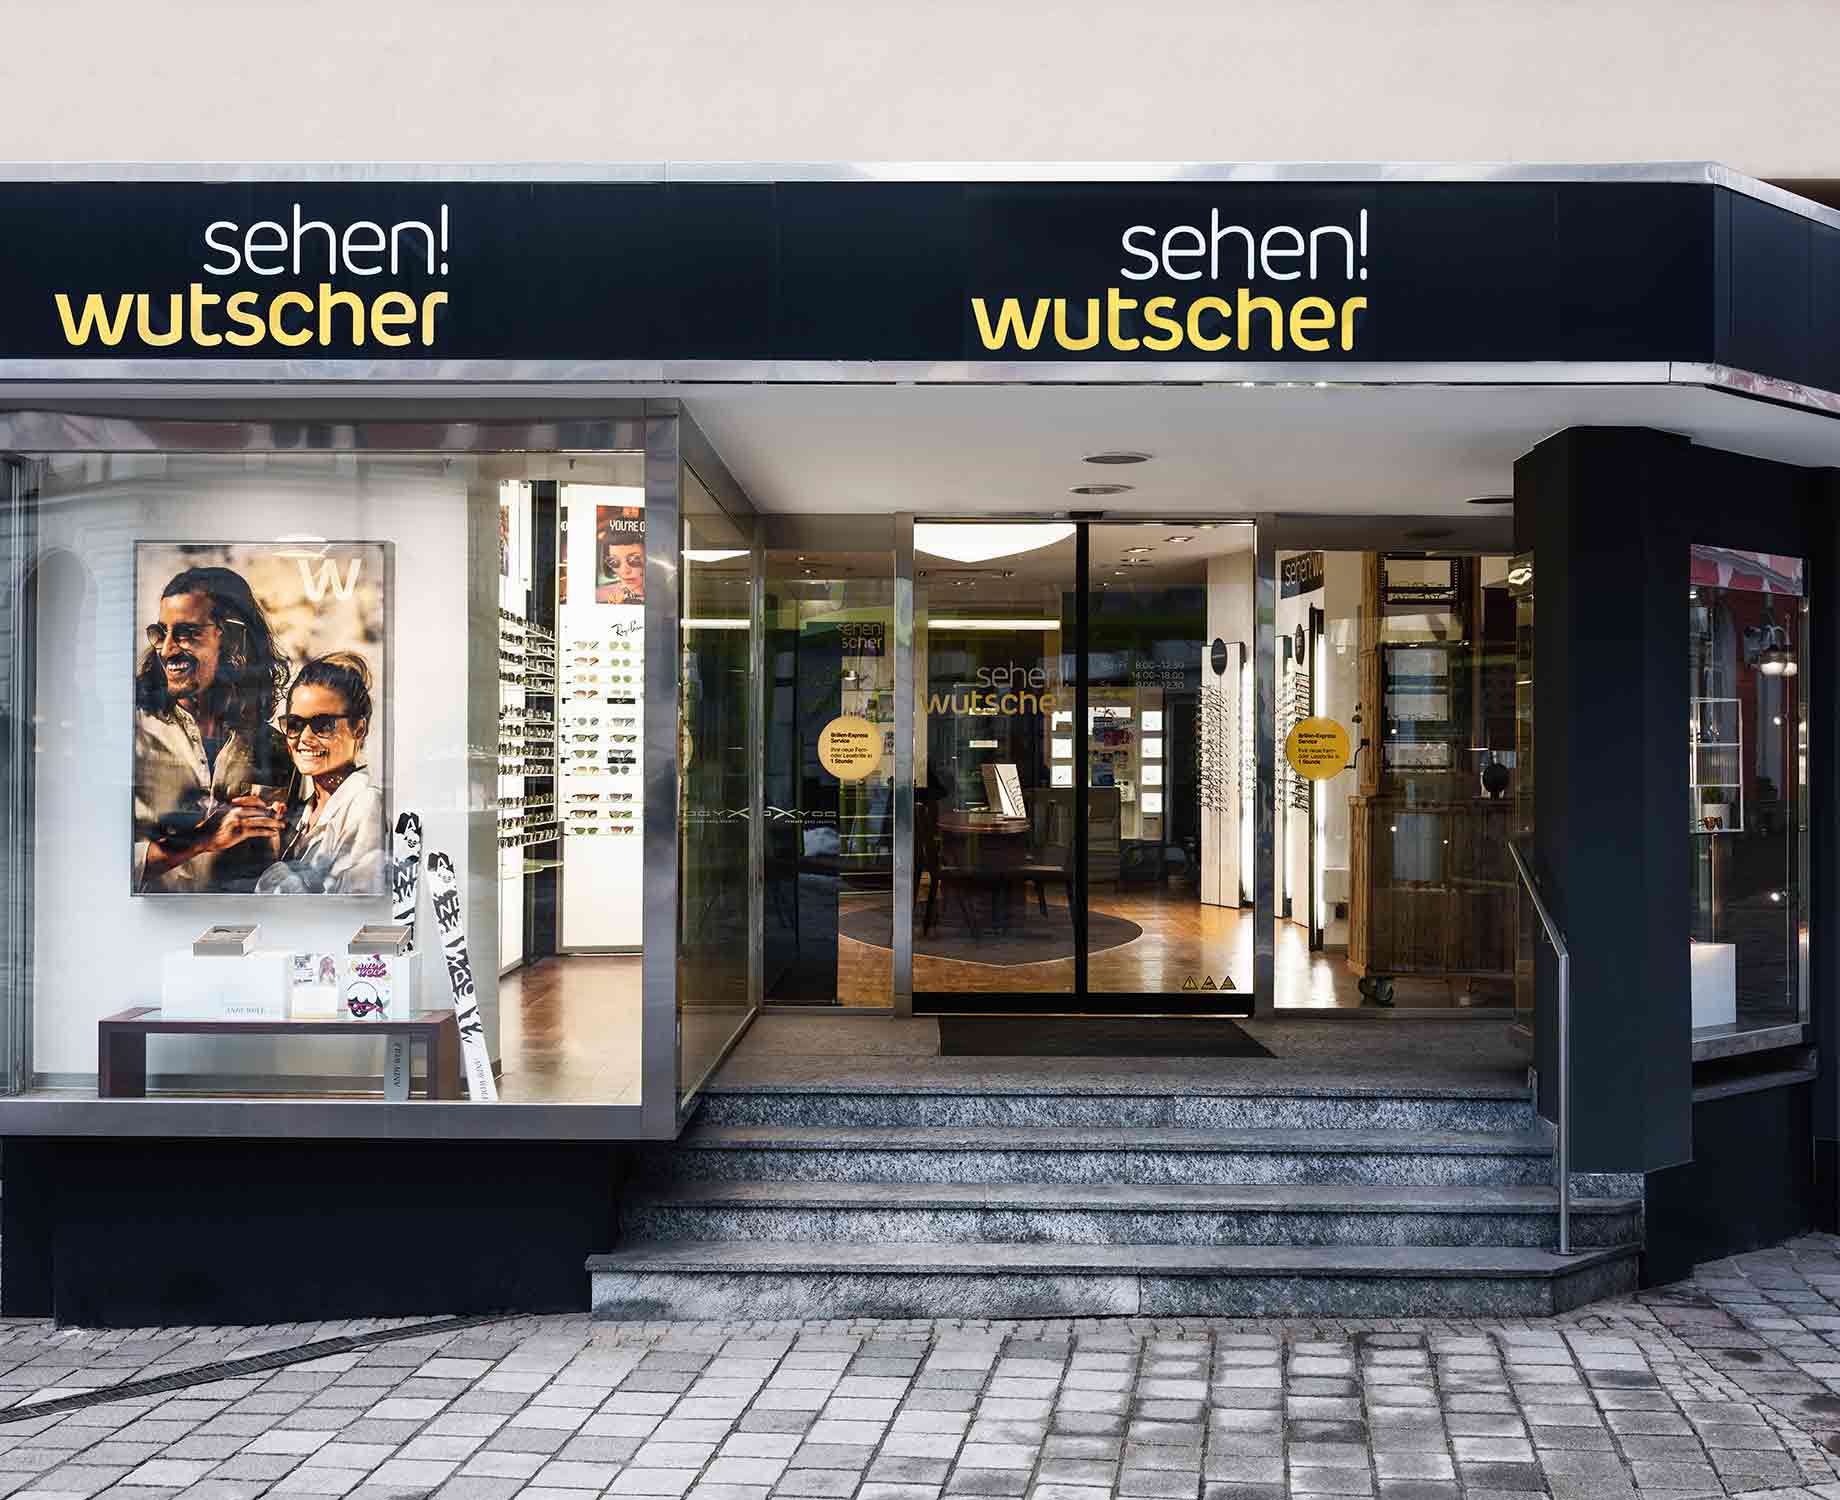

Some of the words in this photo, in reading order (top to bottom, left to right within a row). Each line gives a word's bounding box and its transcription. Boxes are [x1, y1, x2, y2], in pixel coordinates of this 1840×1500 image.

[202, 202, 450, 276] sehen!
[1120, 207, 1368, 281] sehen!
[54, 282, 450, 347] wutscher
[971, 287, 1368, 352] wutscher
[609, 519, 639, 532] YOU'RE
[921, 690, 1059, 716] wutsche
